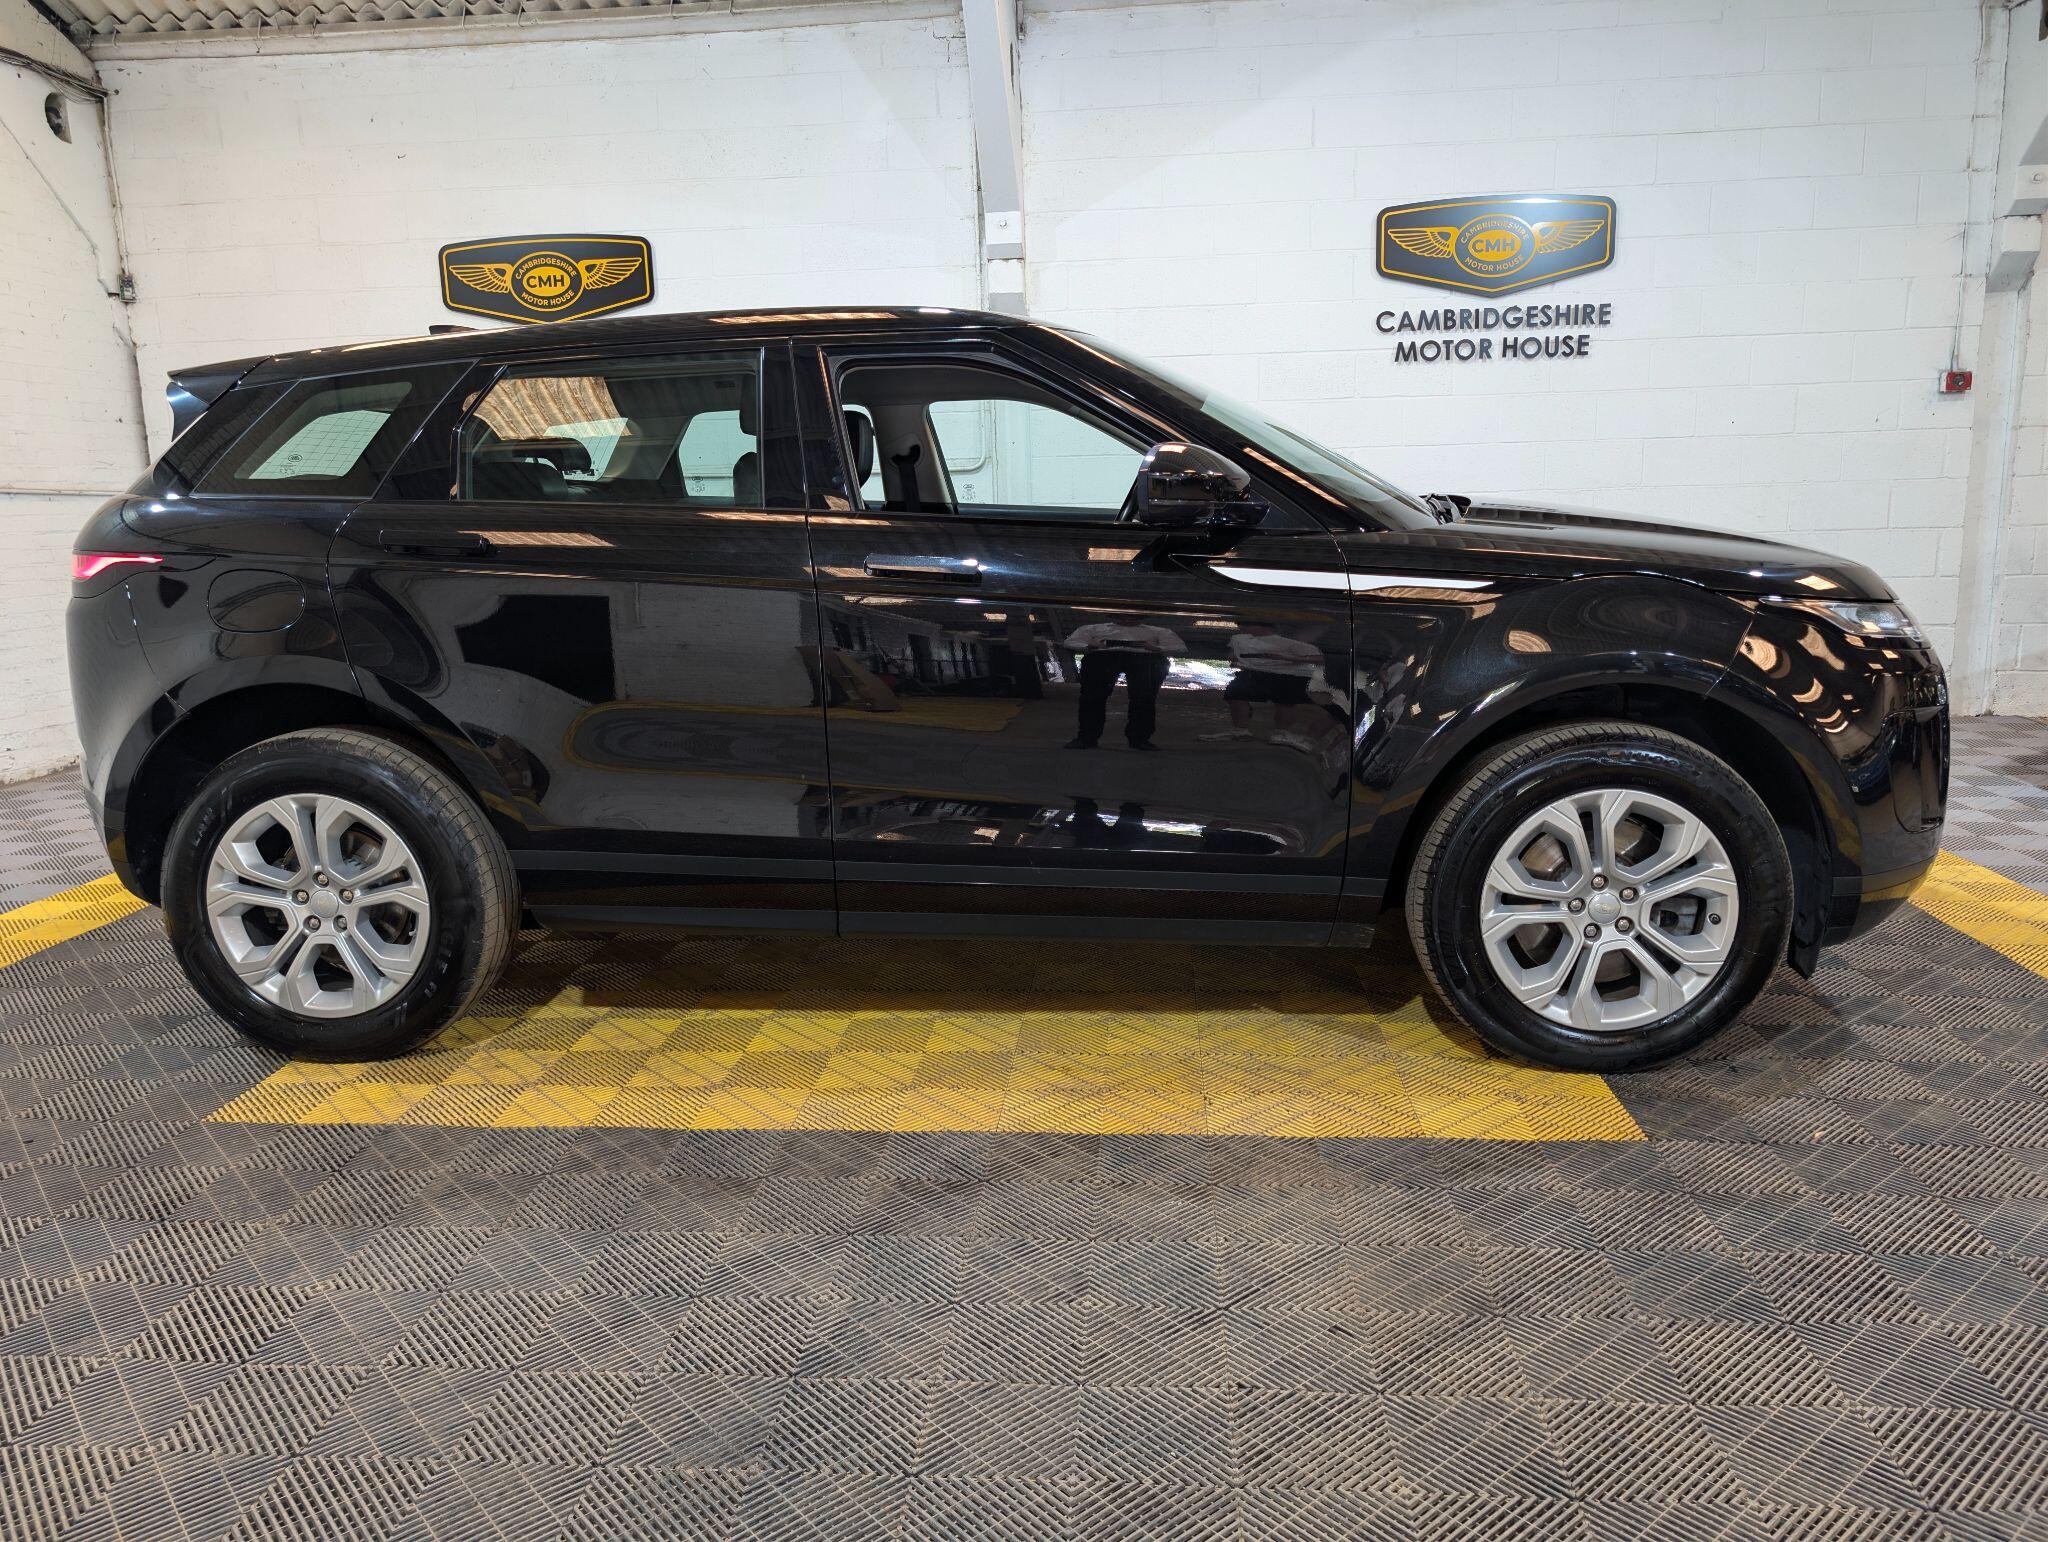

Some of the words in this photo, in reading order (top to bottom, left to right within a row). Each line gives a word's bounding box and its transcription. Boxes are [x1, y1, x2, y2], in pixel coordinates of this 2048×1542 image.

[1461, 219, 1530, 244] CAMBRIDGESHIRE
[1471, 239, 1515, 254] CMH
[515, 257, 577, 280] CAMBRIDGESHIRE
[1464, 256, 1495, 272] MOTOR
[1497, 256, 1522, 271] HOUSE
[526, 275, 565, 288] CMH
[521, 291, 549, 306] MOTOR
[550, 290, 575, 306] HOUSE
[1376, 303, 1611, 332] CAMBRIDGESHIRE
[1394, 338, 1493, 362] MOTOR
[1502, 334, 1590, 359] HOUSE
